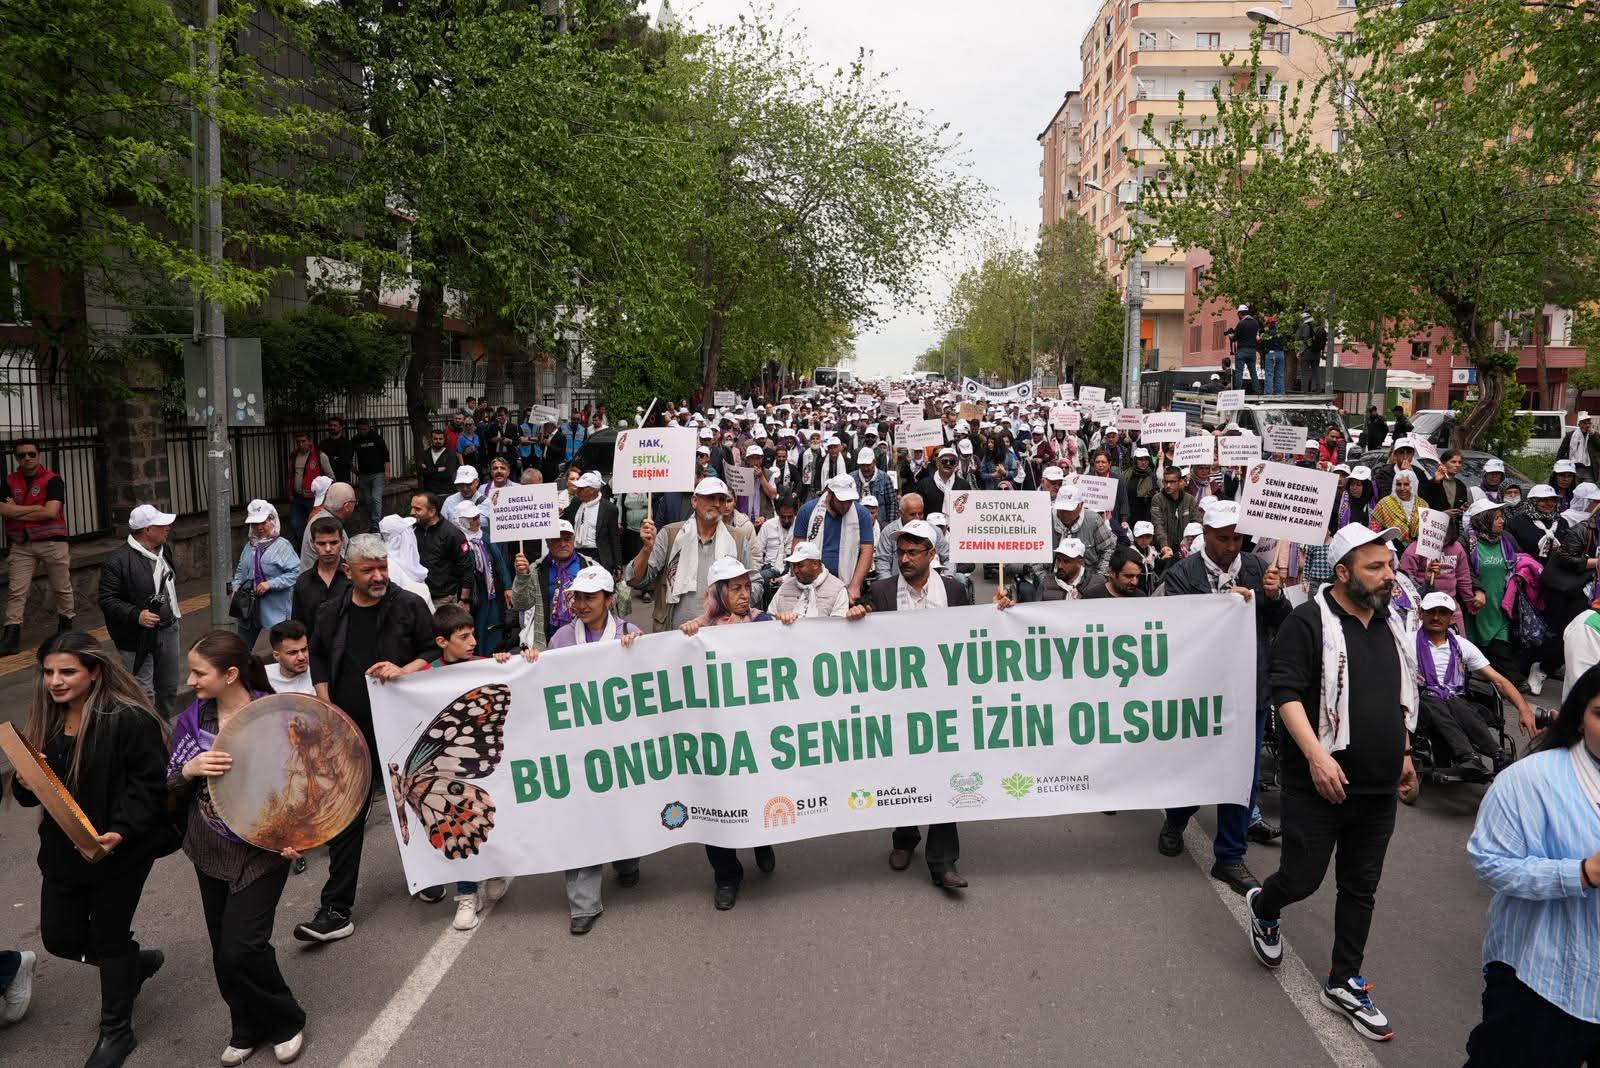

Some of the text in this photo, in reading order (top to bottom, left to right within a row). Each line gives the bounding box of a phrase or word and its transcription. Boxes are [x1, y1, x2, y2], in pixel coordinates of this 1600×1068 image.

[639, 439, 664, 448] HAK,
[632, 453, 670, 466] EŞİTLİK,
[632, 467, 669, 480] ERİŞİM!
[1265, 478, 1319, 494] SENİN BEDENİN,
[508, 494, 534, 503] ENGELLİ
[1262, 488, 1318, 505] SENİN KARARIN!
[539, 502, 554, 510] GİBİ
[975, 501, 1029, 510] BASTONLAR
[1250, 498, 1323, 517] HANİ BENİM BEDENİM,
[495, 513, 540, 522] MÜCADELEMİZ
[980, 513, 1025, 523] SOKAKTA,
[1247, 509, 1323, 529] HANİ BENİM KARARIM!
[496, 521, 551, 531] ONURLU OLACAK!
[967, 524, 1037, 535] HİSSEDİLEBİLİR
[959, 539, 1045, 550] ZEMİN NEREDE?
[543, 621, 1169, 731] ENGELLİLER ONUR YÜRÜYÜŞÜ
[510, 692, 1223, 804] BU ONURDA SENİN DE İZİN OLSUN!
[1036, 775, 1089, 783] KAYAPINAR
[876, 787, 917, 797] BAĞLAR
[1037, 782, 1090, 793] BELEDİYESİ
[796, 796, 827, 810] SUR
[877, 793, 932, 807] BELEDİYESİ
[690, 806, 748, 818] DİYARBAKIR
